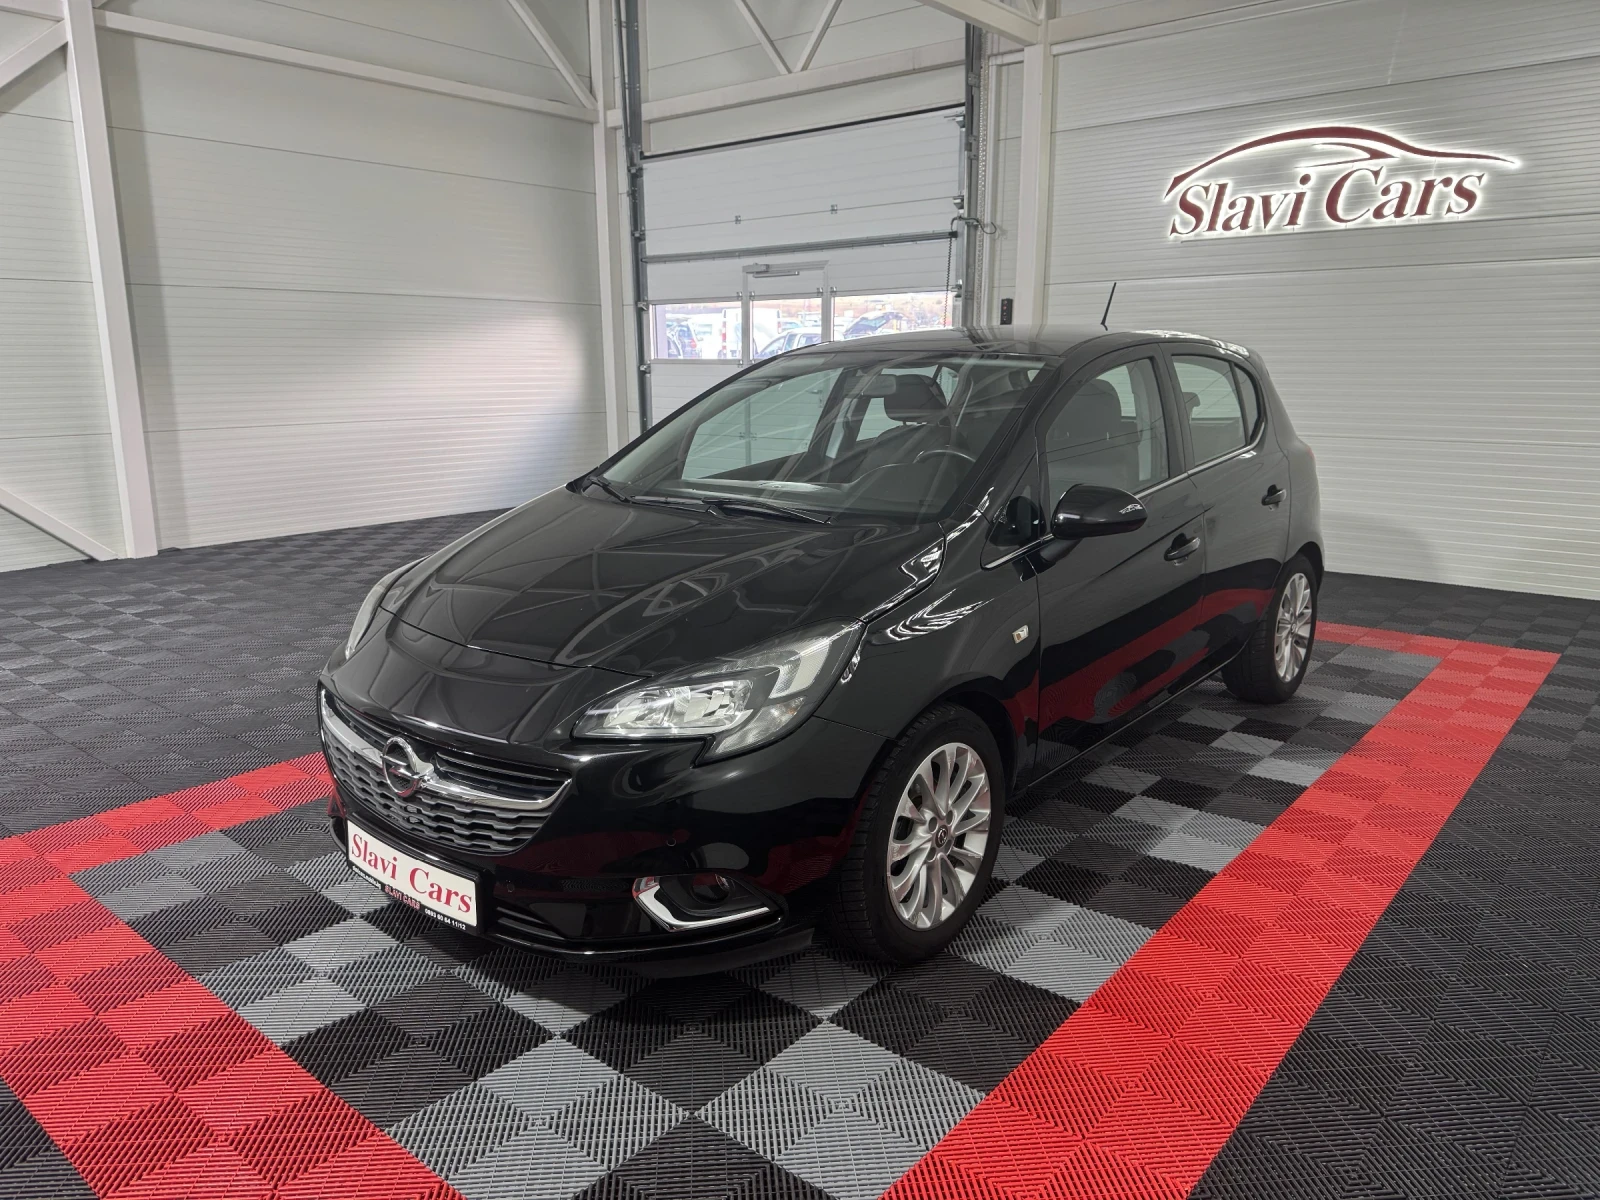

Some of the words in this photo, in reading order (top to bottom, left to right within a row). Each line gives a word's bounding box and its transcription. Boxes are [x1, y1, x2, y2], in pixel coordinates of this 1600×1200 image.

[1170, 173, 1312, 237] Slavi
[1325, 166, 1486, 224] Cars
[352, 833, 398, 880] Slavi
[409, 867, 472, 913] Cars
[385, 885, 402, 901] SLAVI
[403, 895, 420, 910] CARS
